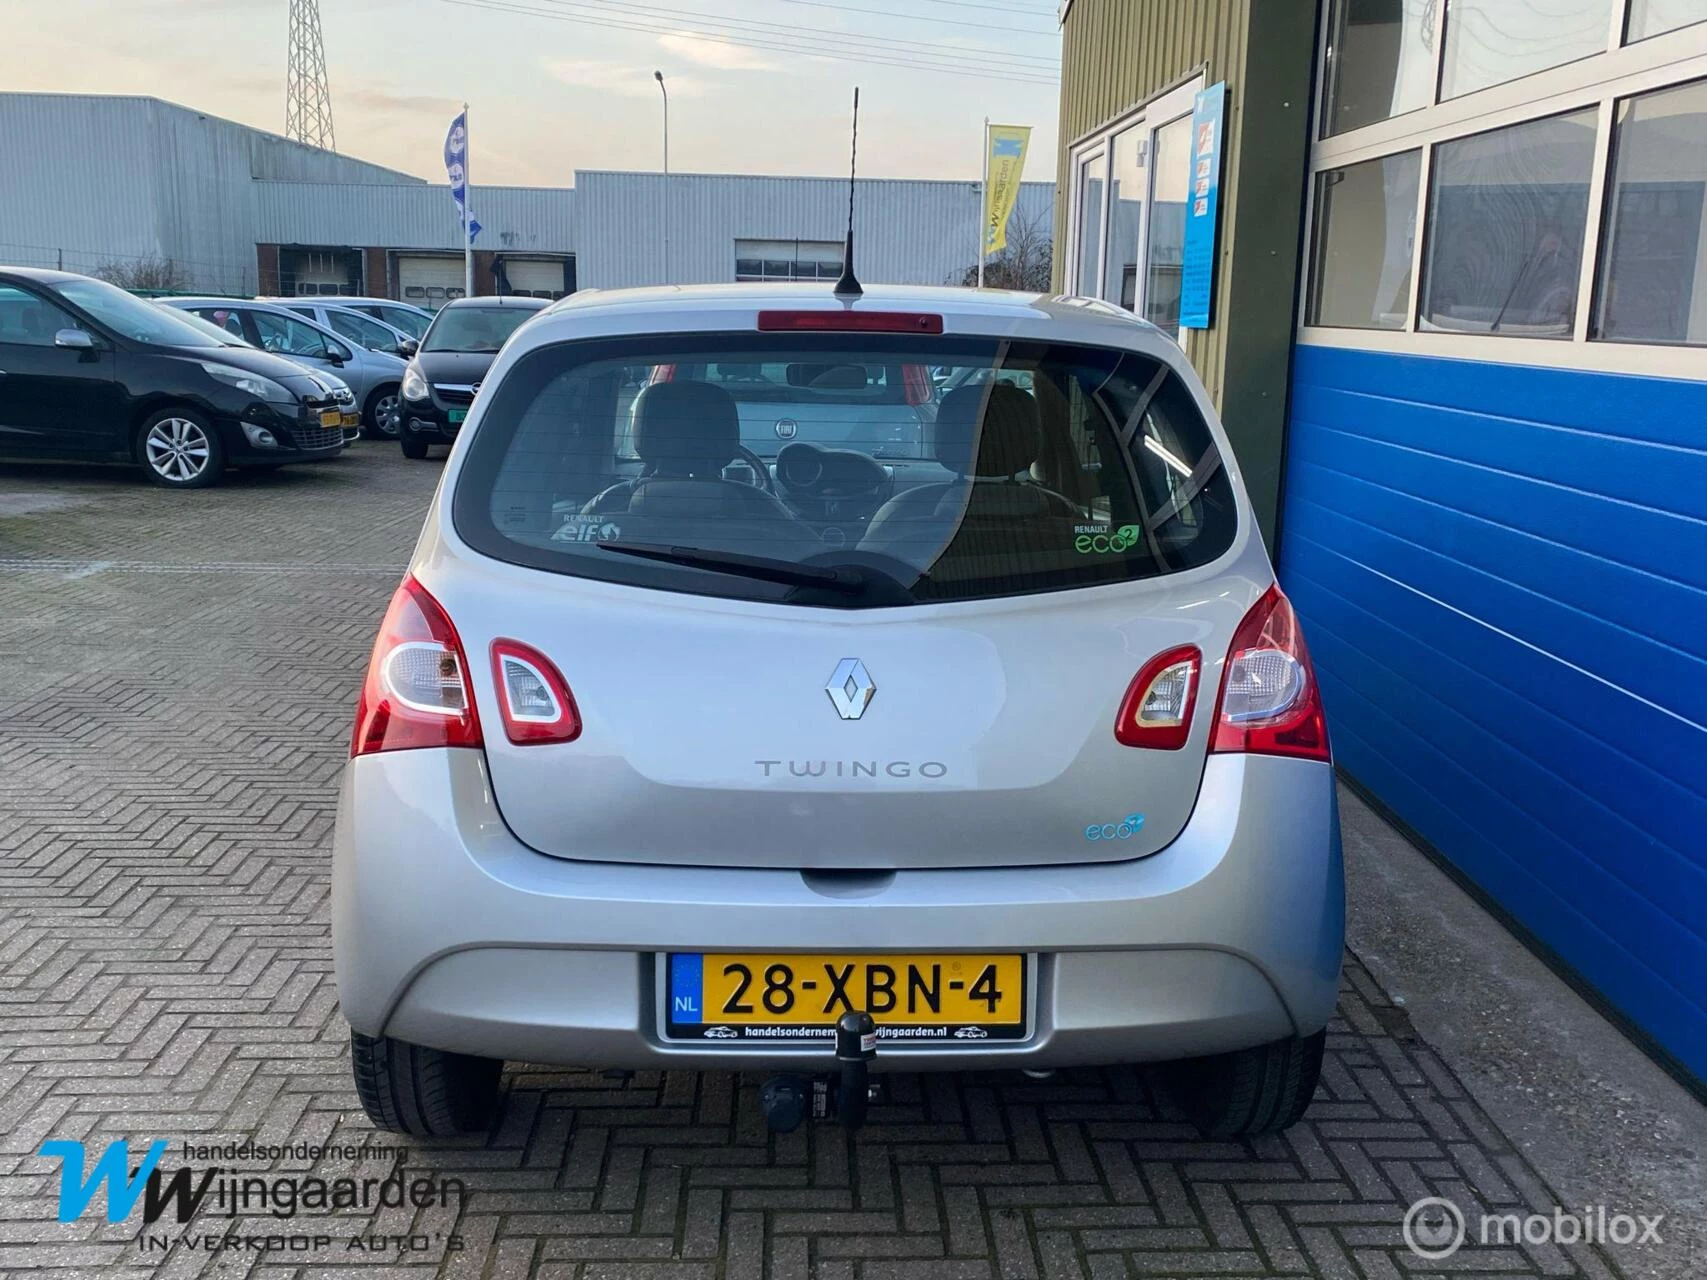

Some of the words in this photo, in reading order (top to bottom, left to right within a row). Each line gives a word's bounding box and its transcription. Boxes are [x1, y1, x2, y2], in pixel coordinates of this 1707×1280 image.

[563, 514, 605, 523] RENAULT
[561, 524, 599, 542] elf
[1074, 525, 1108, 534] RENAULT
[754, 760, 948, 778] TWINGO
[675, 997, 698, 1012] NL
[722, 963, 1002, 1014] 28-XBN-4
